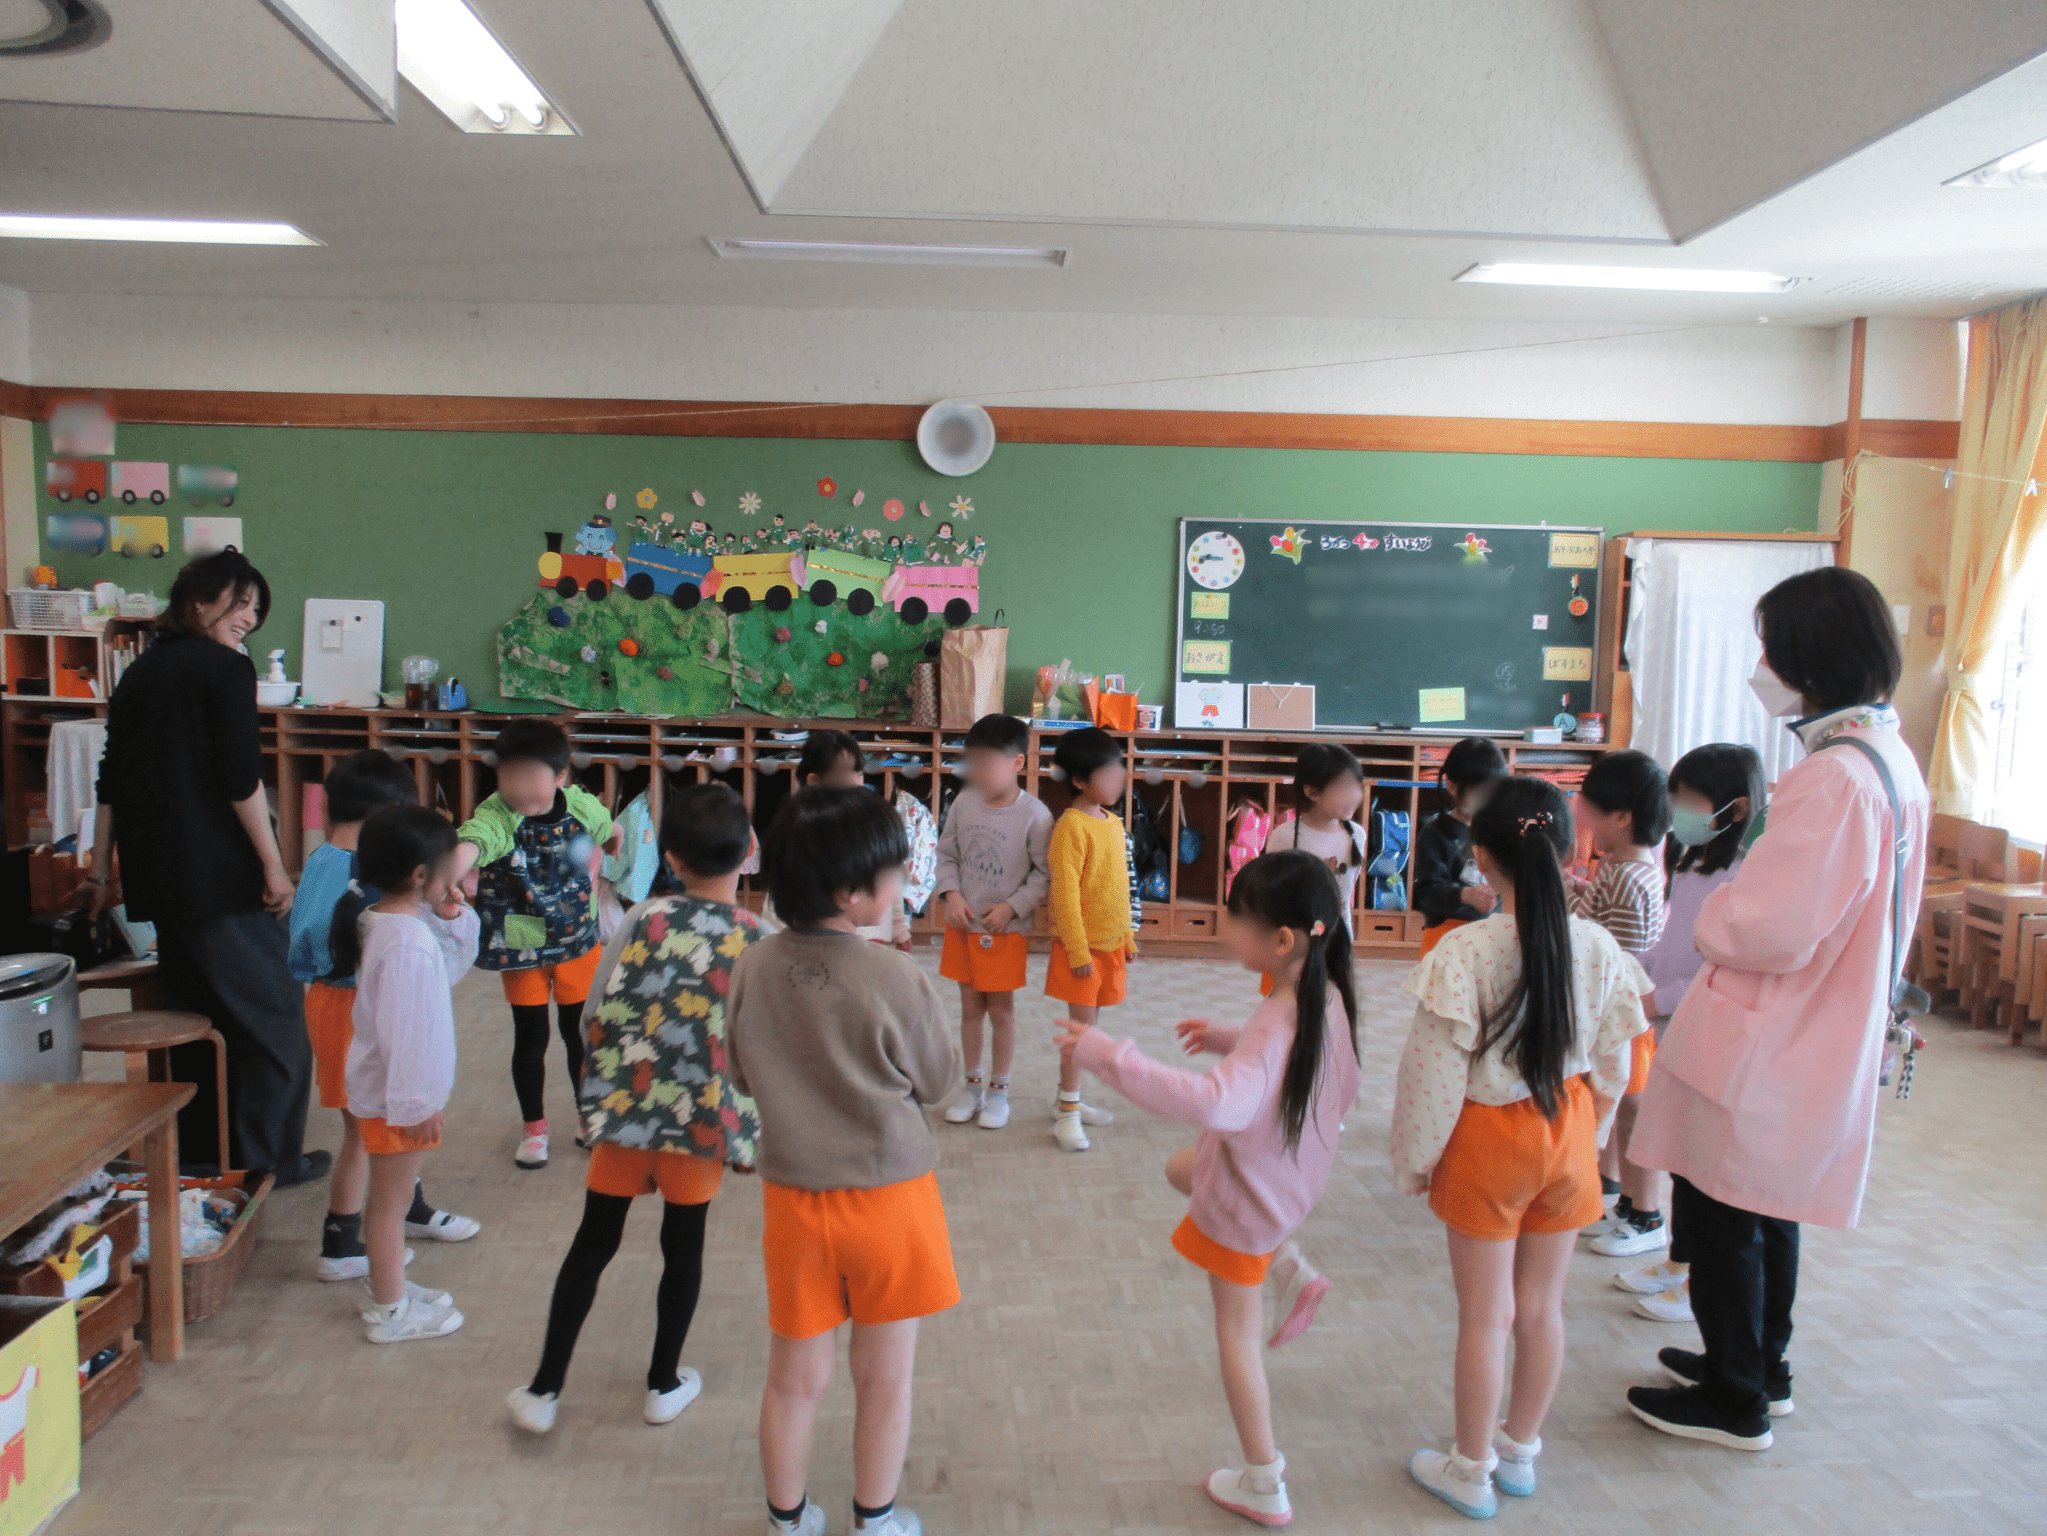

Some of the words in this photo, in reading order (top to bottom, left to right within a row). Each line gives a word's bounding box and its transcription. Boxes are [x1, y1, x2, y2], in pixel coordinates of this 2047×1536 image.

[1383, 532, 1433, 552] すいようび
